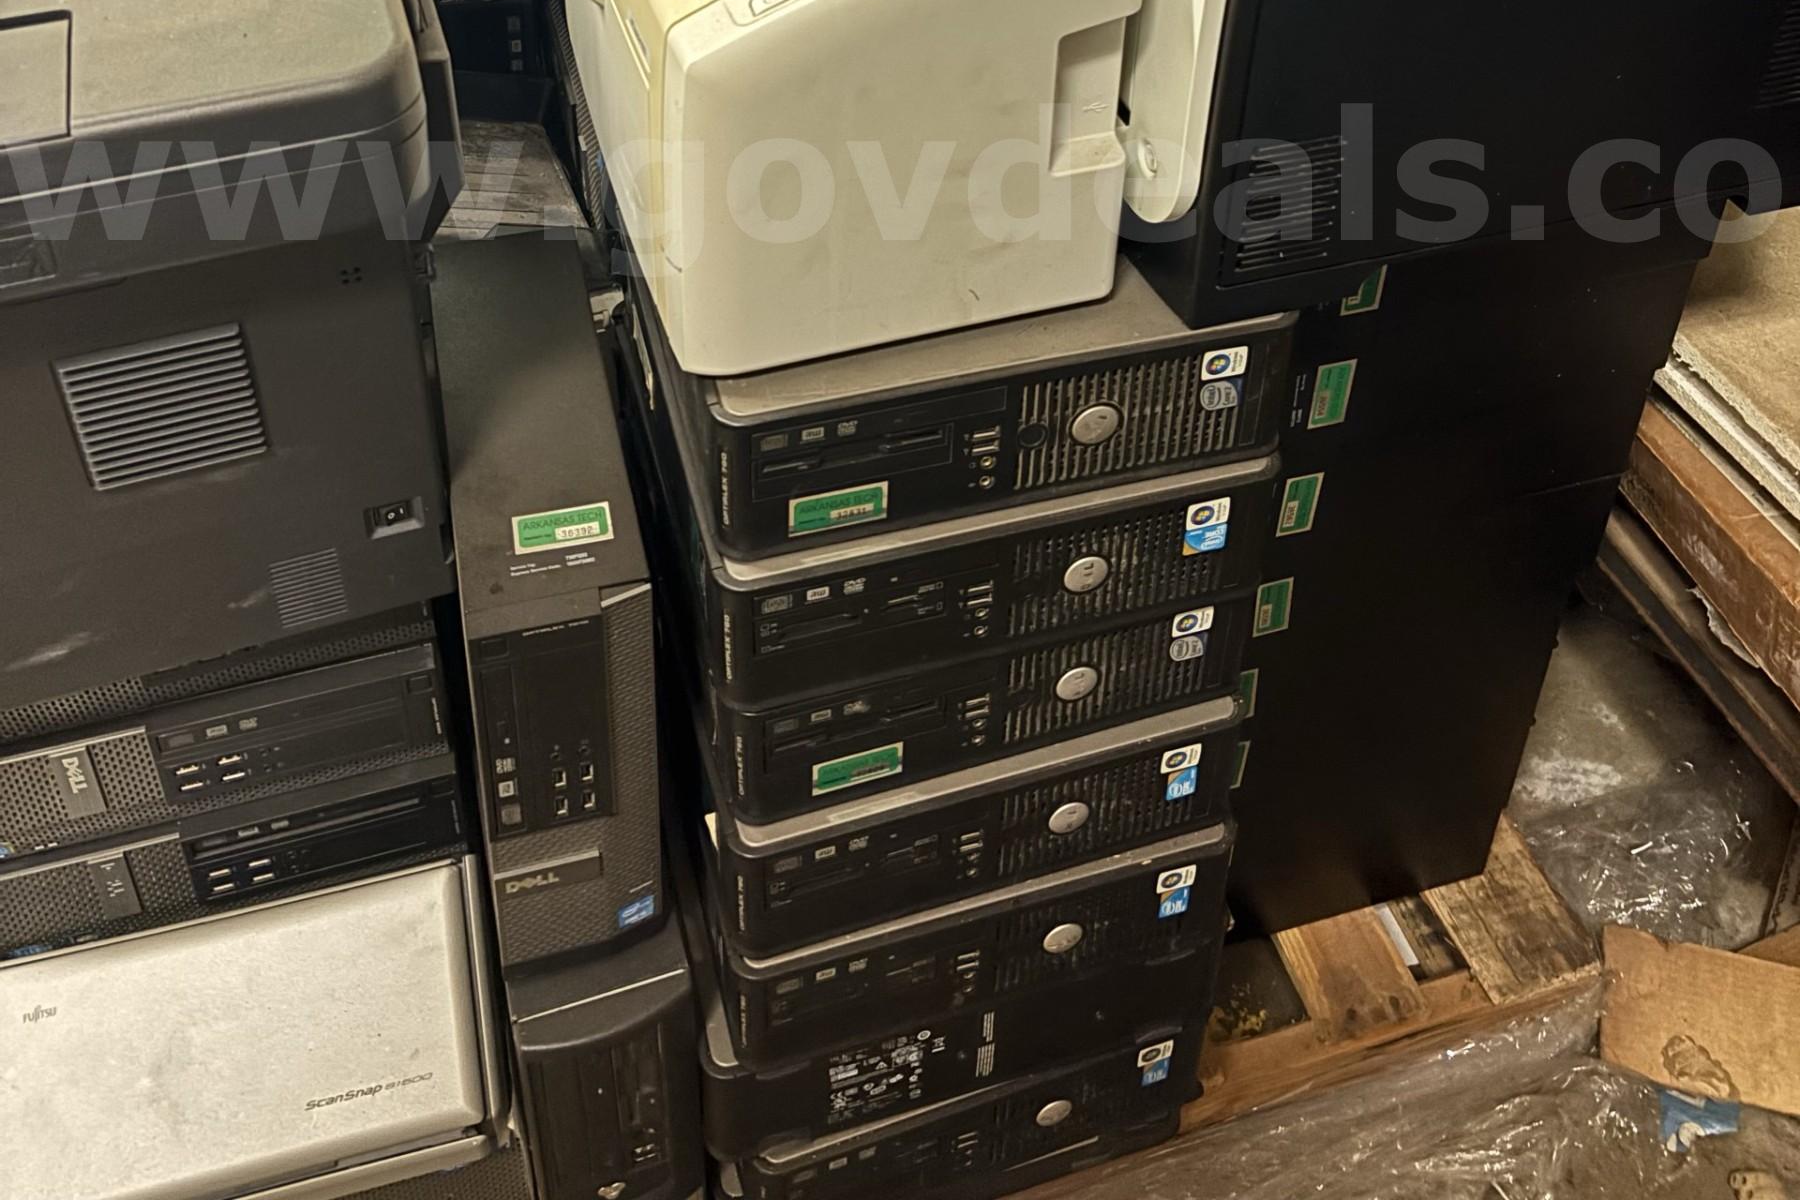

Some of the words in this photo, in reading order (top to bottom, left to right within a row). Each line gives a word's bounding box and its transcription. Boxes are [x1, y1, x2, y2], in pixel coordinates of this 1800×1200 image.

[522, 514, 576, 530] ARKANSAS
[577, 511, 603, 522] TECH
[61, 757, 88, 795] DELL
[505, 872, 561, 894] DELL
[22, 1004, 57, 1024] FUJITSU
[303, 1083, 383, 1112] ScanSnap
